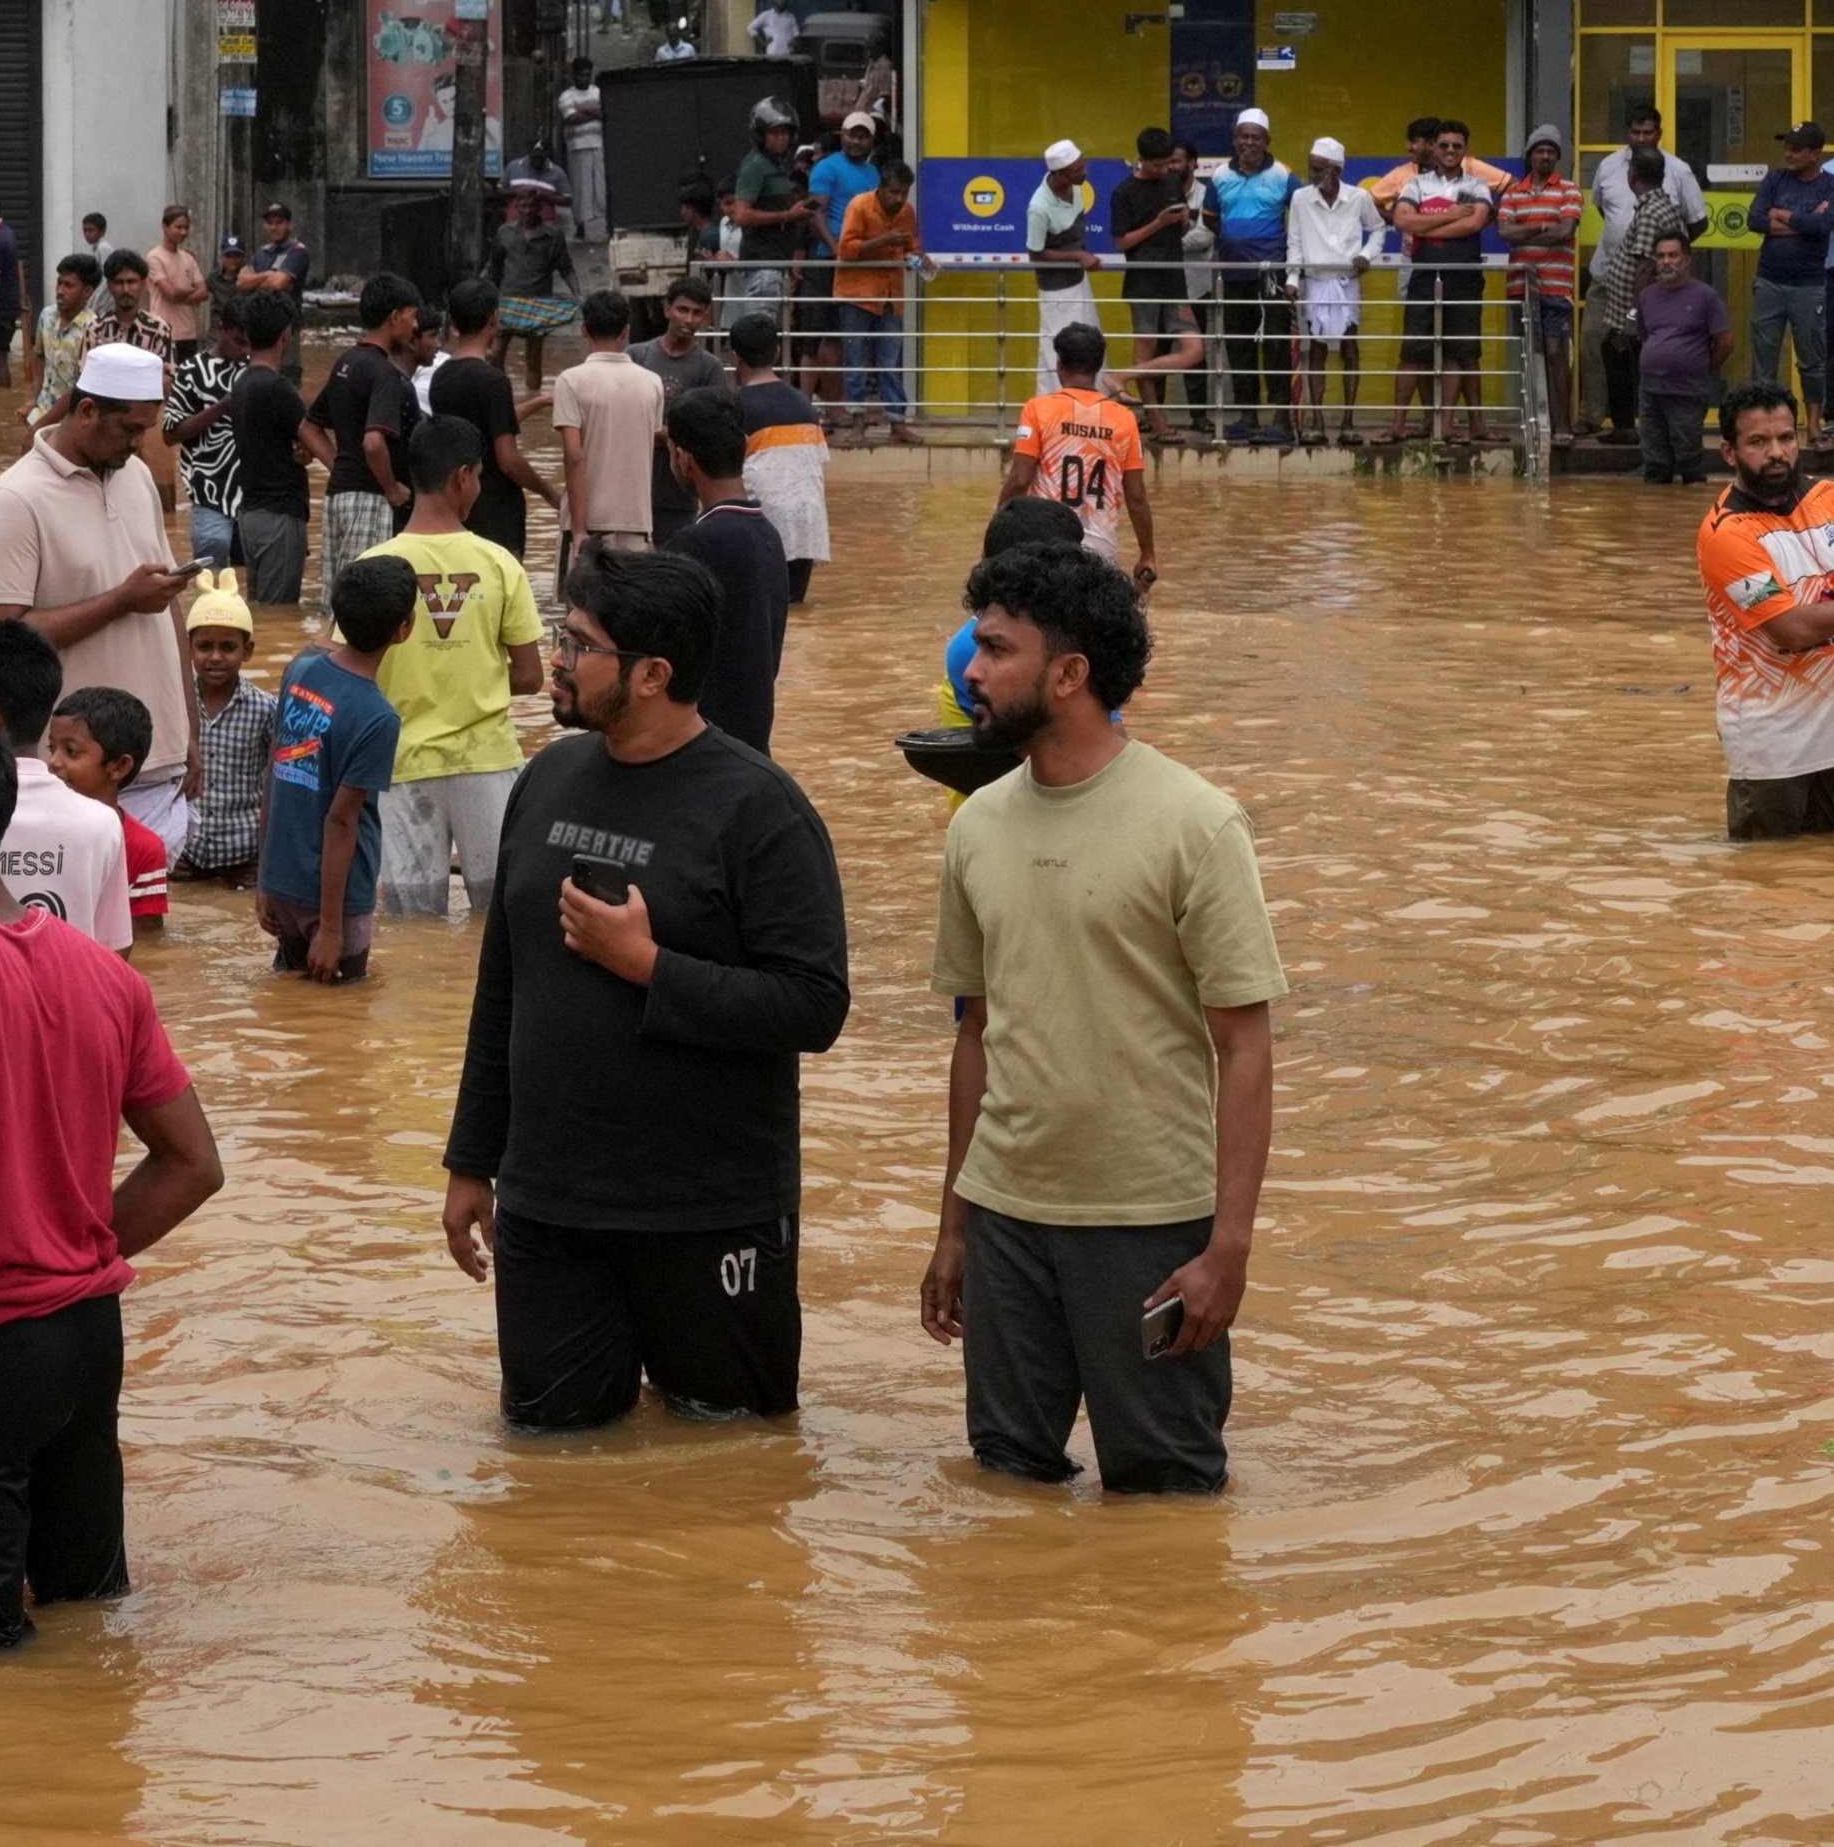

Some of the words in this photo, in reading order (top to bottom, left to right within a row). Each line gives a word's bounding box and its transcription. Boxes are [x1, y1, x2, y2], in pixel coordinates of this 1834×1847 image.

[952, 223, 992, 232] Withdraw
[994, 223, 1015, 232] Cash
[1060, 454, 1107, 510] 04
[545, 820, 656, 866] BREATHE
[720, 1247, 757, 1297] 07
